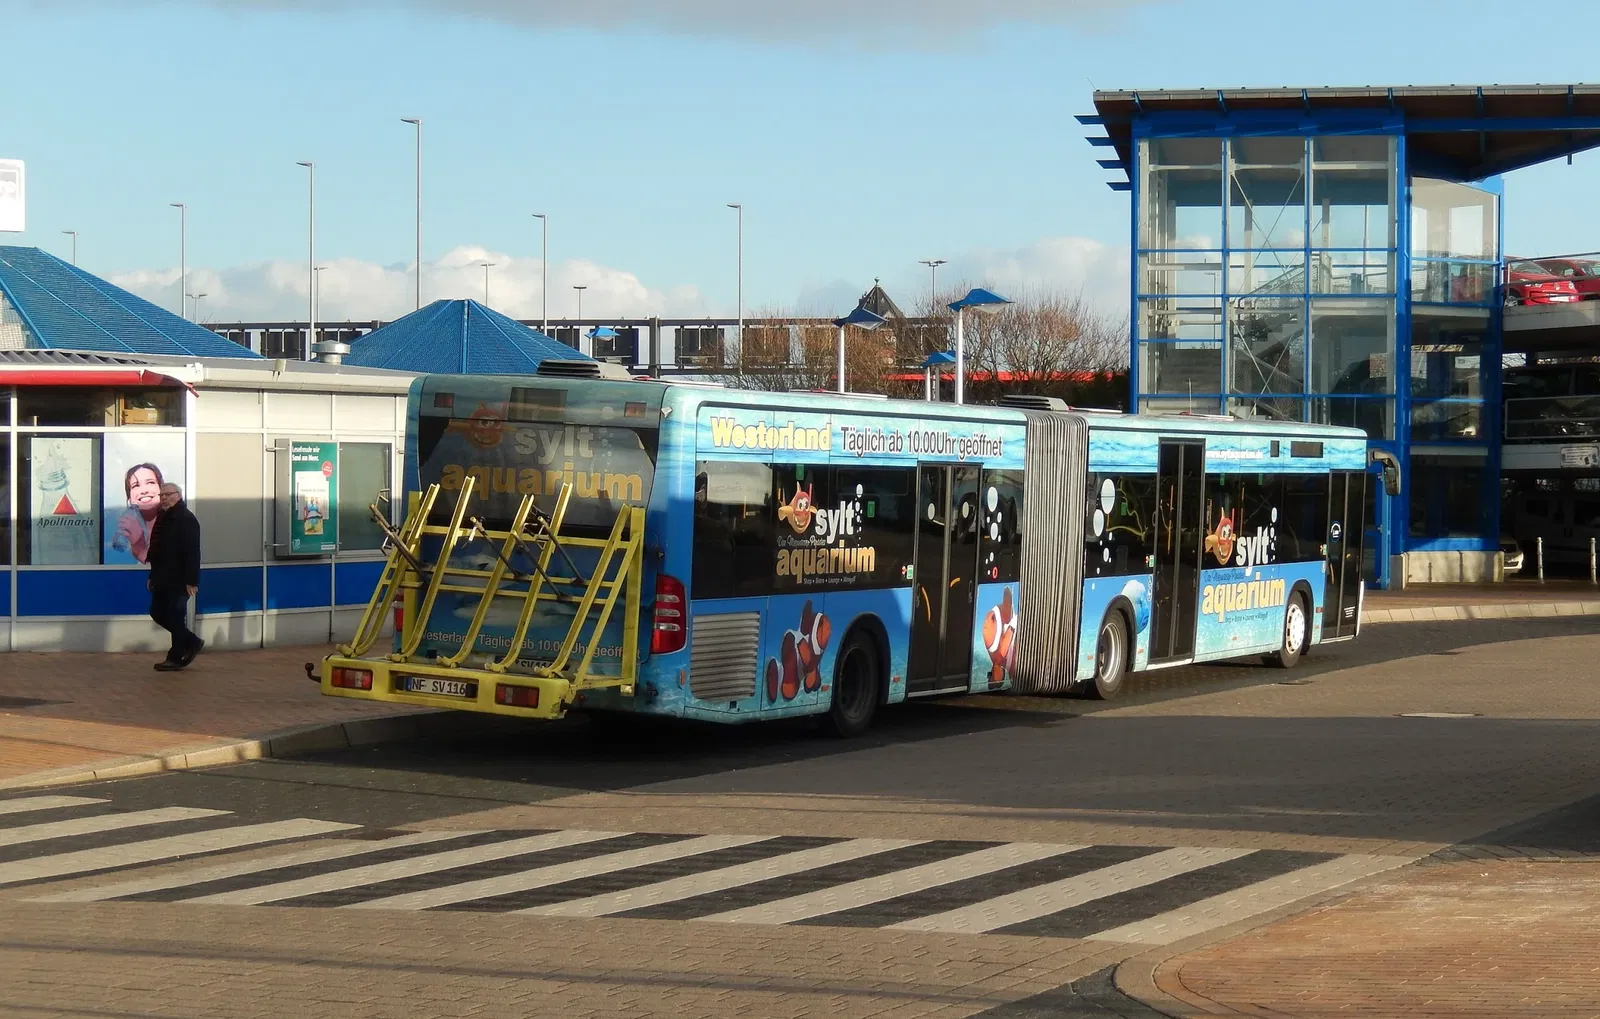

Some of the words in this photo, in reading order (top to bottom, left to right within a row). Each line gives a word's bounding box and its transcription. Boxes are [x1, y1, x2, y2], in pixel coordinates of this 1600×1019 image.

[514, 424, 594, 464] sylt
[710, 416, 831, 451] Westerland
[841, 426, 885, 457] Täglich
[888, 429, 904, 453] ab
[958, 432, 1002, 460] geöffnet
[441, 462, 642, 501] aquarium
[36, 518, 94, 528] Apollinaris
[815, 501, 854, 544] sylt
[776, 540, 875, 584] aquarium
[1236, 526, 1270, 576] sylt
[1202, 572, 1285, 622] aquarium
[412, 678, 426, 690] NF
[432, 681, 446, 692] SV
[447, 682, 465, 694] 116
